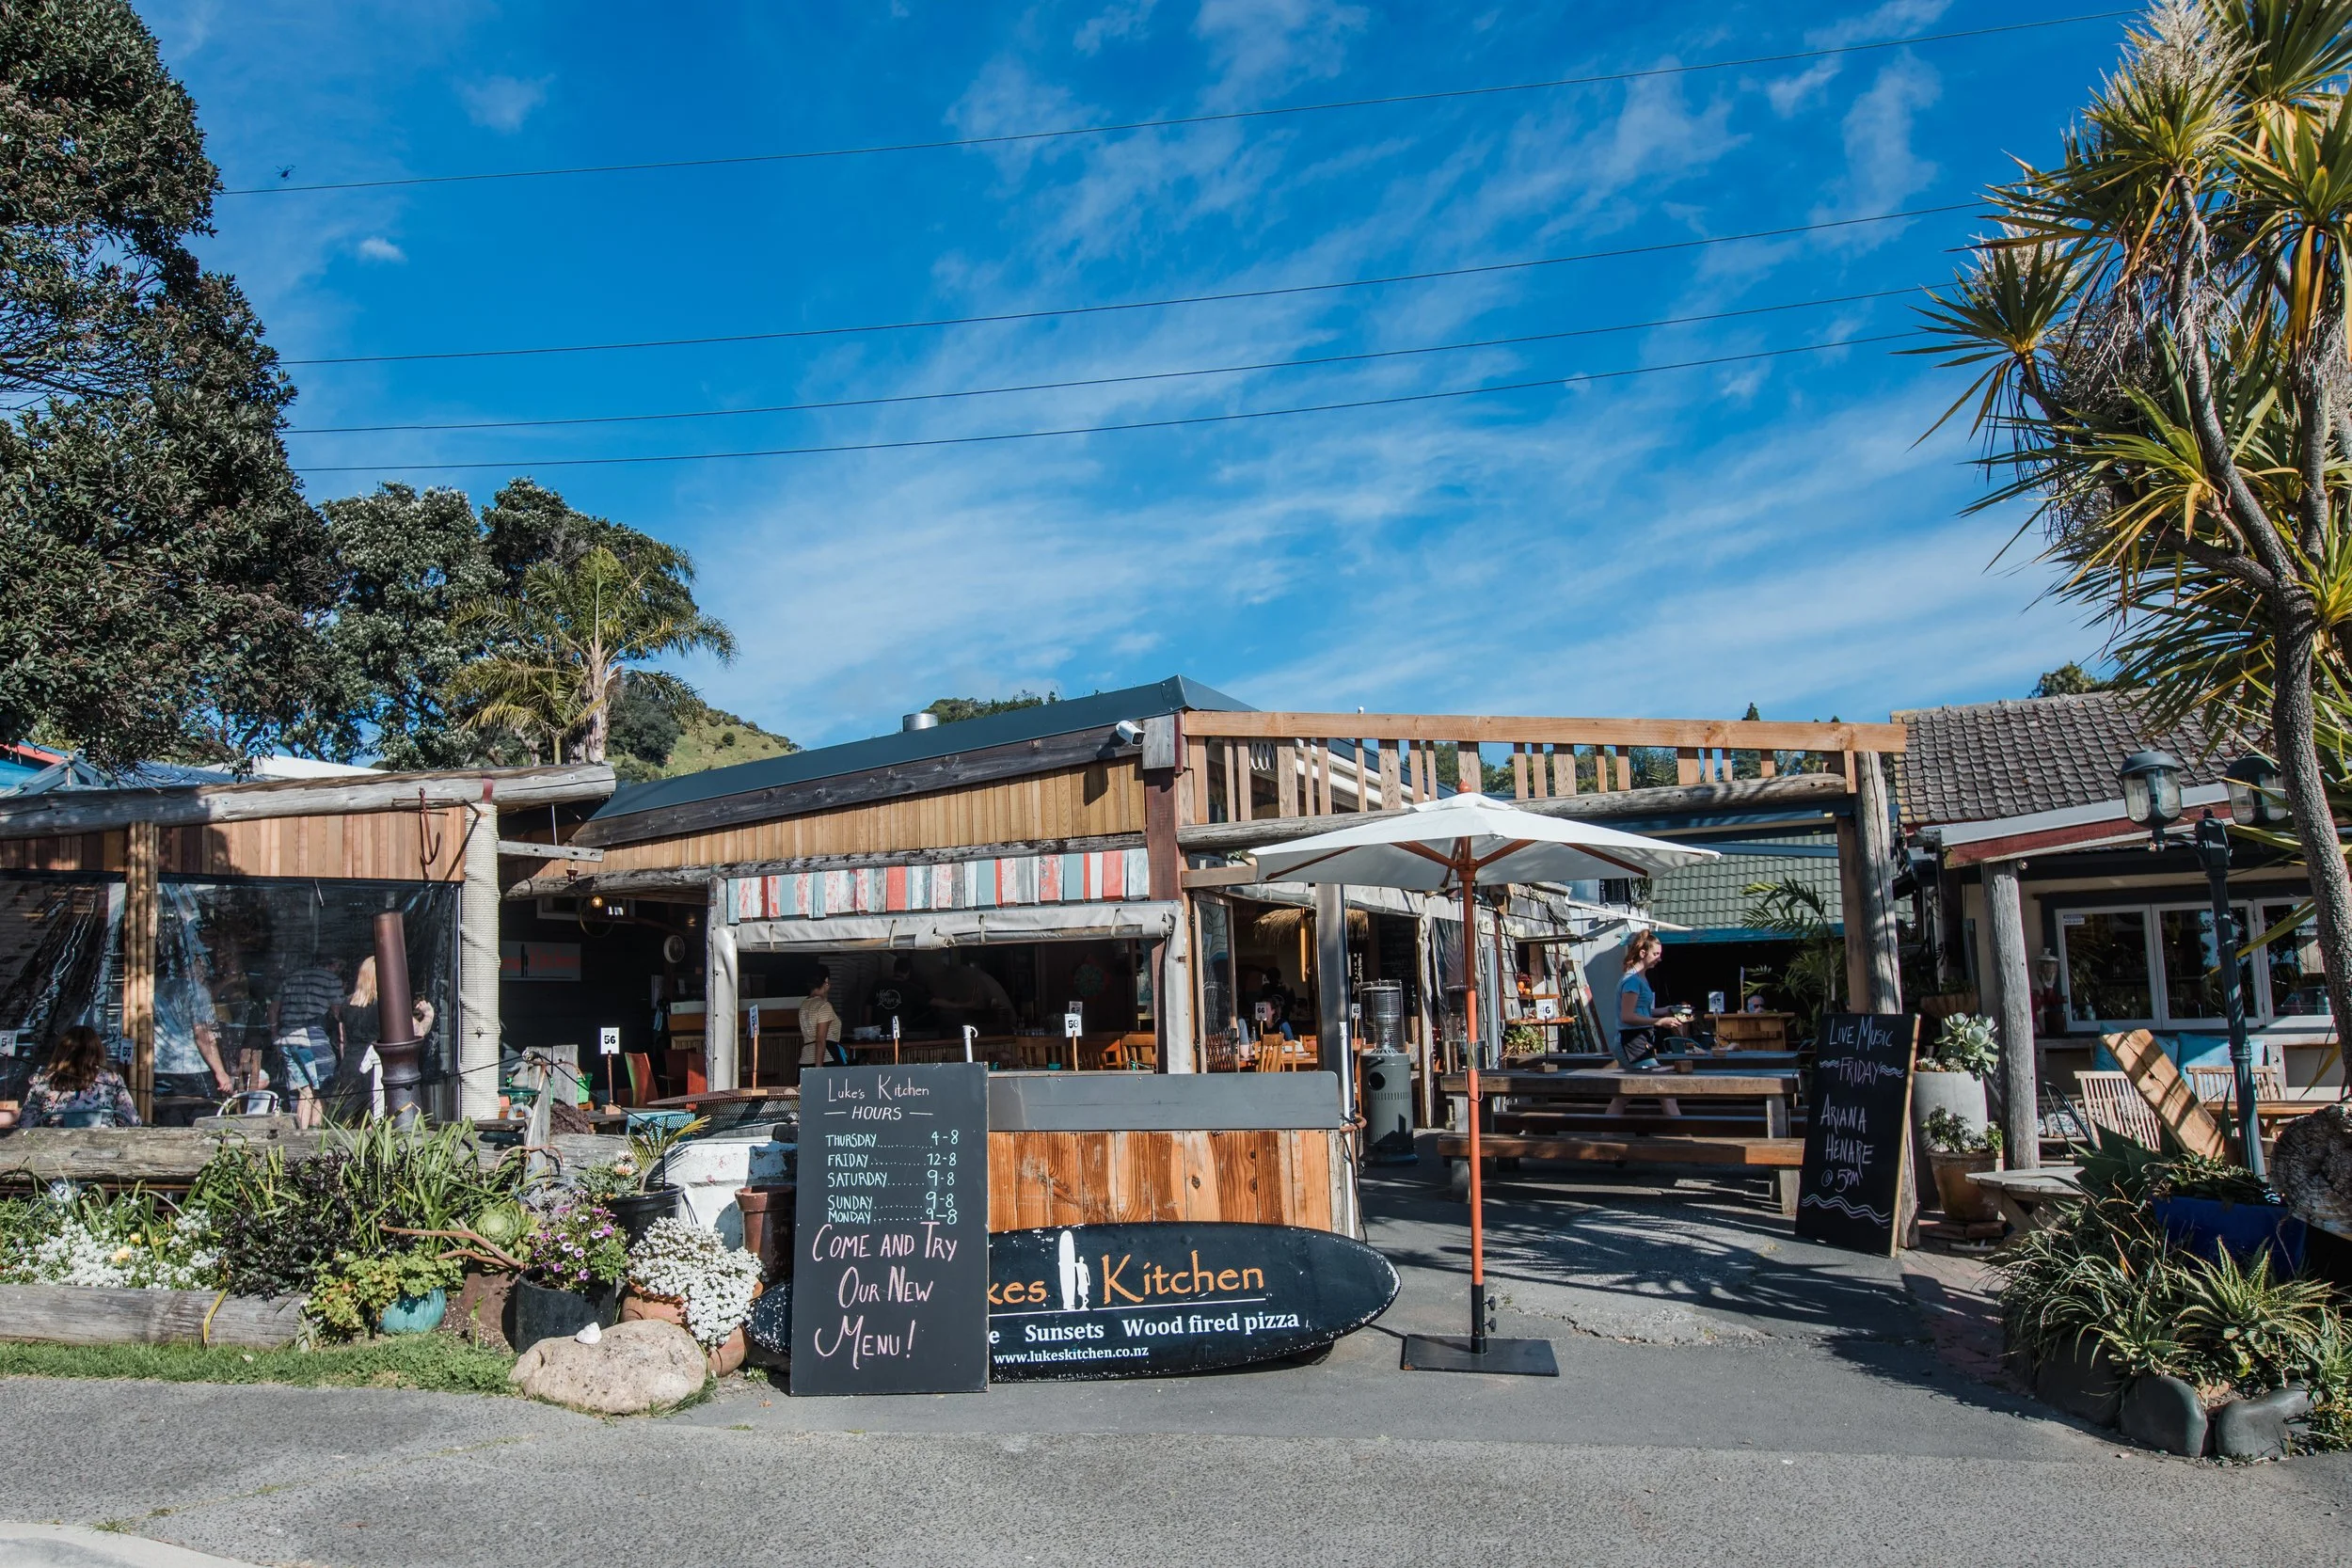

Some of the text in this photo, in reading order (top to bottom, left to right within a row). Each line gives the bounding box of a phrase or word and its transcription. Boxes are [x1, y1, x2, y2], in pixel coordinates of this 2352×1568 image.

[603, 1035, 616, 1045] 56
[1829, 1015, 1894, 1052] LIVE MUSIC
[1838, 1056, 1882, 1087] FRIDAY
[828, 1074, 930, 1102] Luke's Kitchen
[851, 1105, 902, 1120] HOURS
[1820, 1093, 1867, 1134] ARIANA
[825, 1133, 877, 1148] THURSDAY
[828, 1152, 868, 1168] FRIDAY
[827, 1172, 887, 1188] SATURDAY
[827, 1195, 873, 1211] SUNDAY
[828, 1211, 871, 1224] MONDAY
[812, 1221, 958, 1262] COME AND TRY
[838, 1266, 934, 1308] OUR NEW
[987, 1249, 1265, 1305] kes Kitchen
[1025, 1323, 1104, 1342] Sunsets
[1121, 1318, 1184, 1338] Wood
[1188, 1312, 1240, 1334] fired
[1243, 1313, 1300, 1336] pizza
[993, 1347, 1150, 1364] www.lukeskitchen.co.nz
